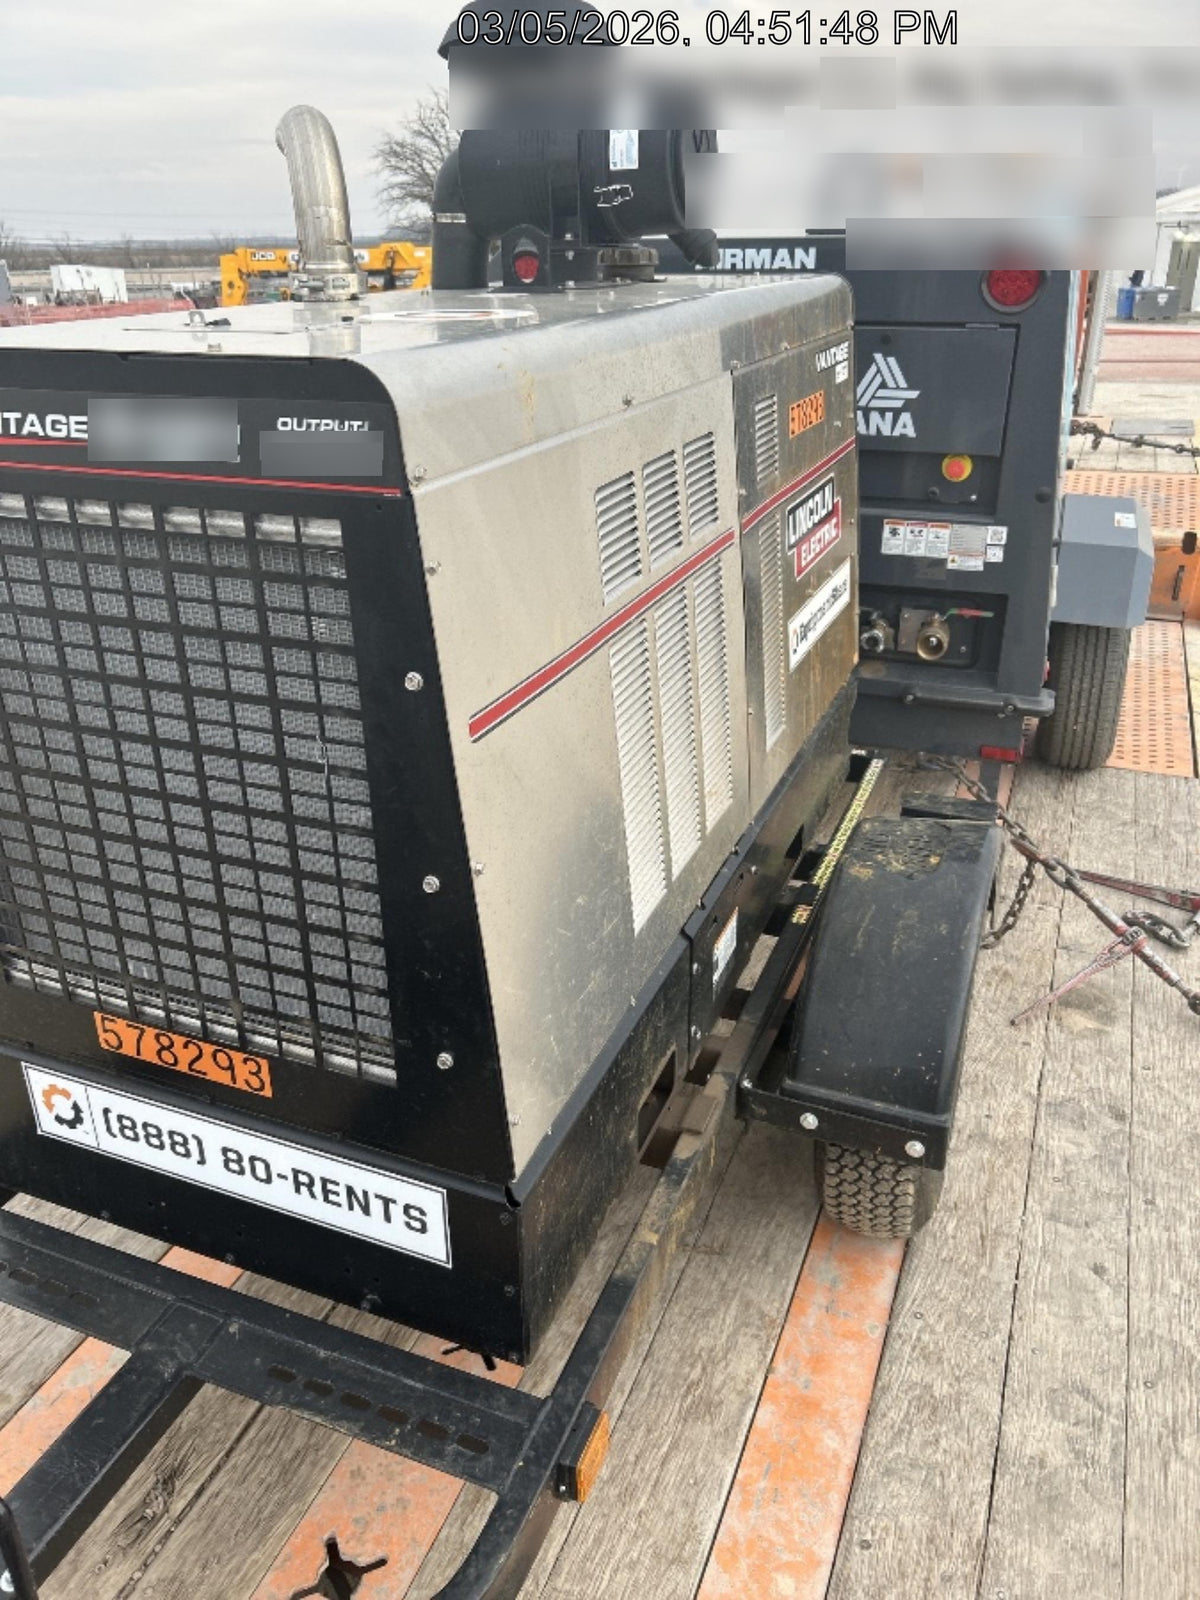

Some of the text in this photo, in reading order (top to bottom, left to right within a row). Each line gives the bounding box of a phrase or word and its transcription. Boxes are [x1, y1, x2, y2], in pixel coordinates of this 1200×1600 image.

[0, 411, 88, 439] TAGE
[788, 482, 833, 545] LINCOLN
[801, 516, 838, 568] ELECTRIC
[100, 1018, 268, 1093] 578293
[102, 1106, 429, 1235] (888) 80-RENTS
